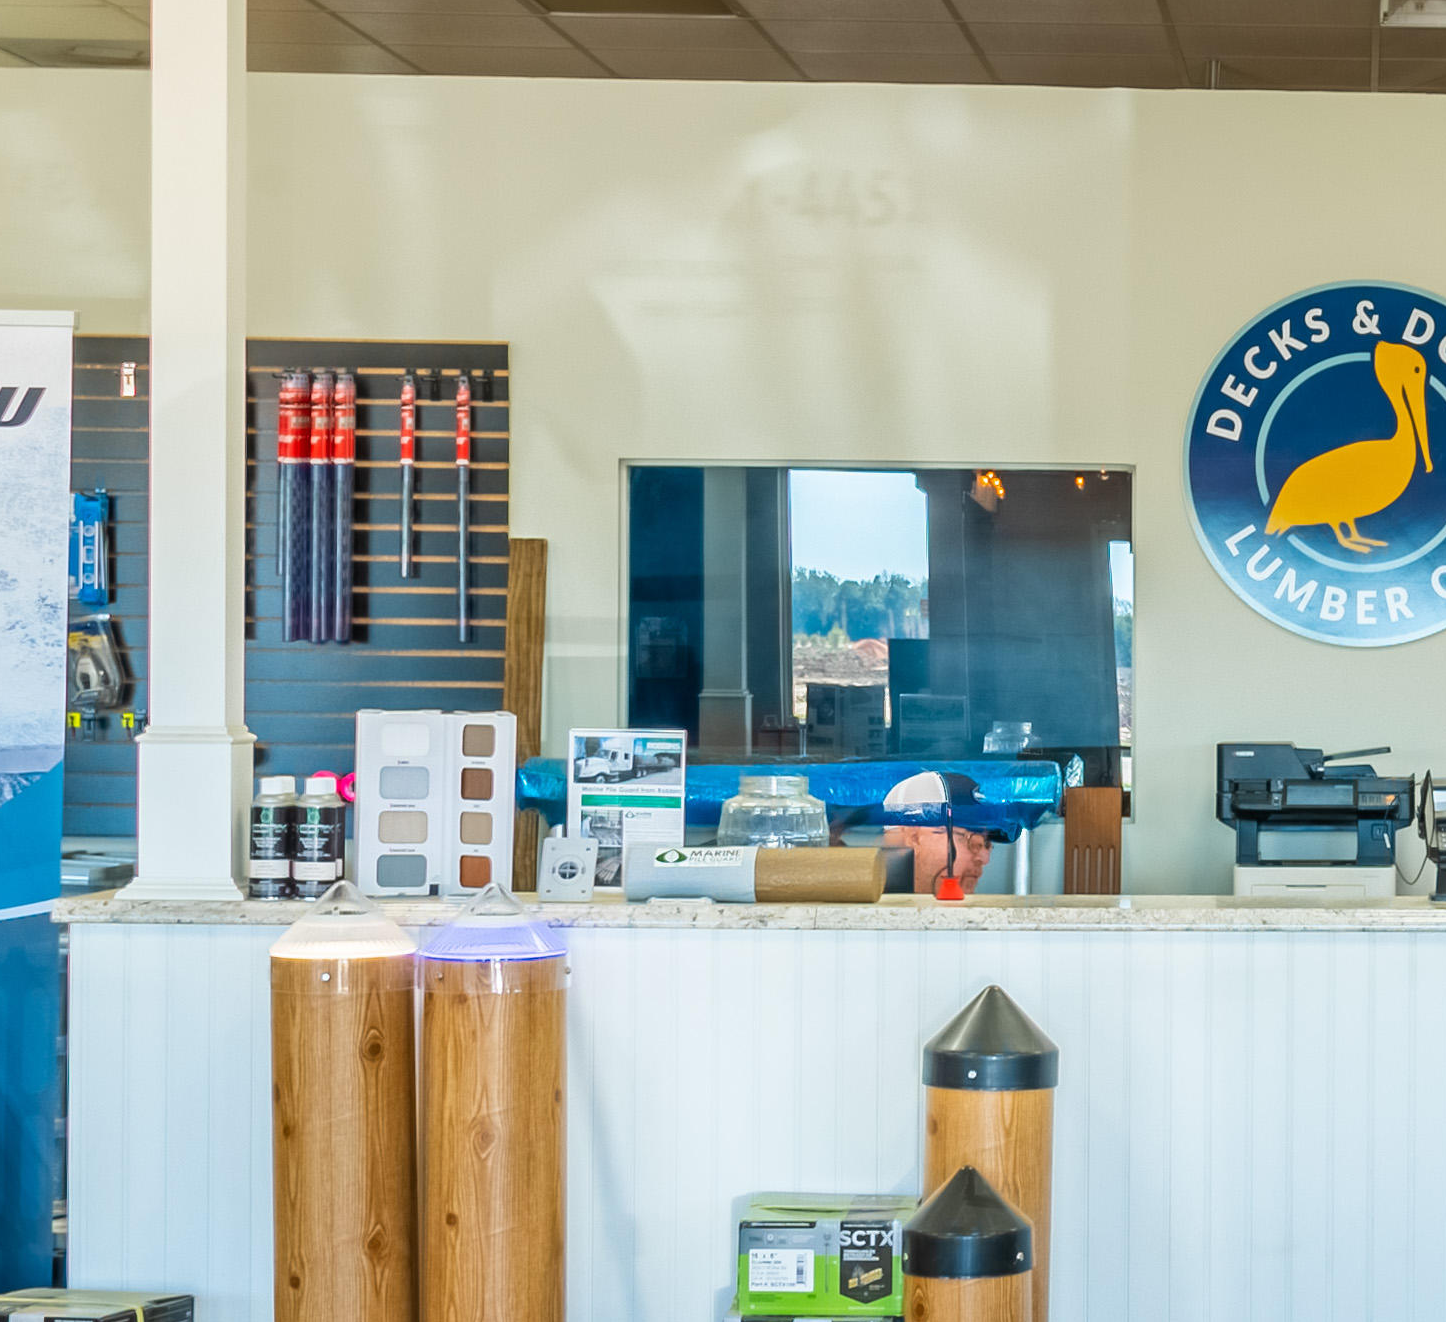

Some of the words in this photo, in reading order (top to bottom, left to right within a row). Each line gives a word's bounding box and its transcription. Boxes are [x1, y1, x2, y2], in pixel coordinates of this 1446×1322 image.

[1205, 307, 1331, 442] DECKS
[1352, 299, 1381, 336] &
[1224, 523, 1415, 625] LUMBER
[839, 1230, 894, 1247] SCTX
